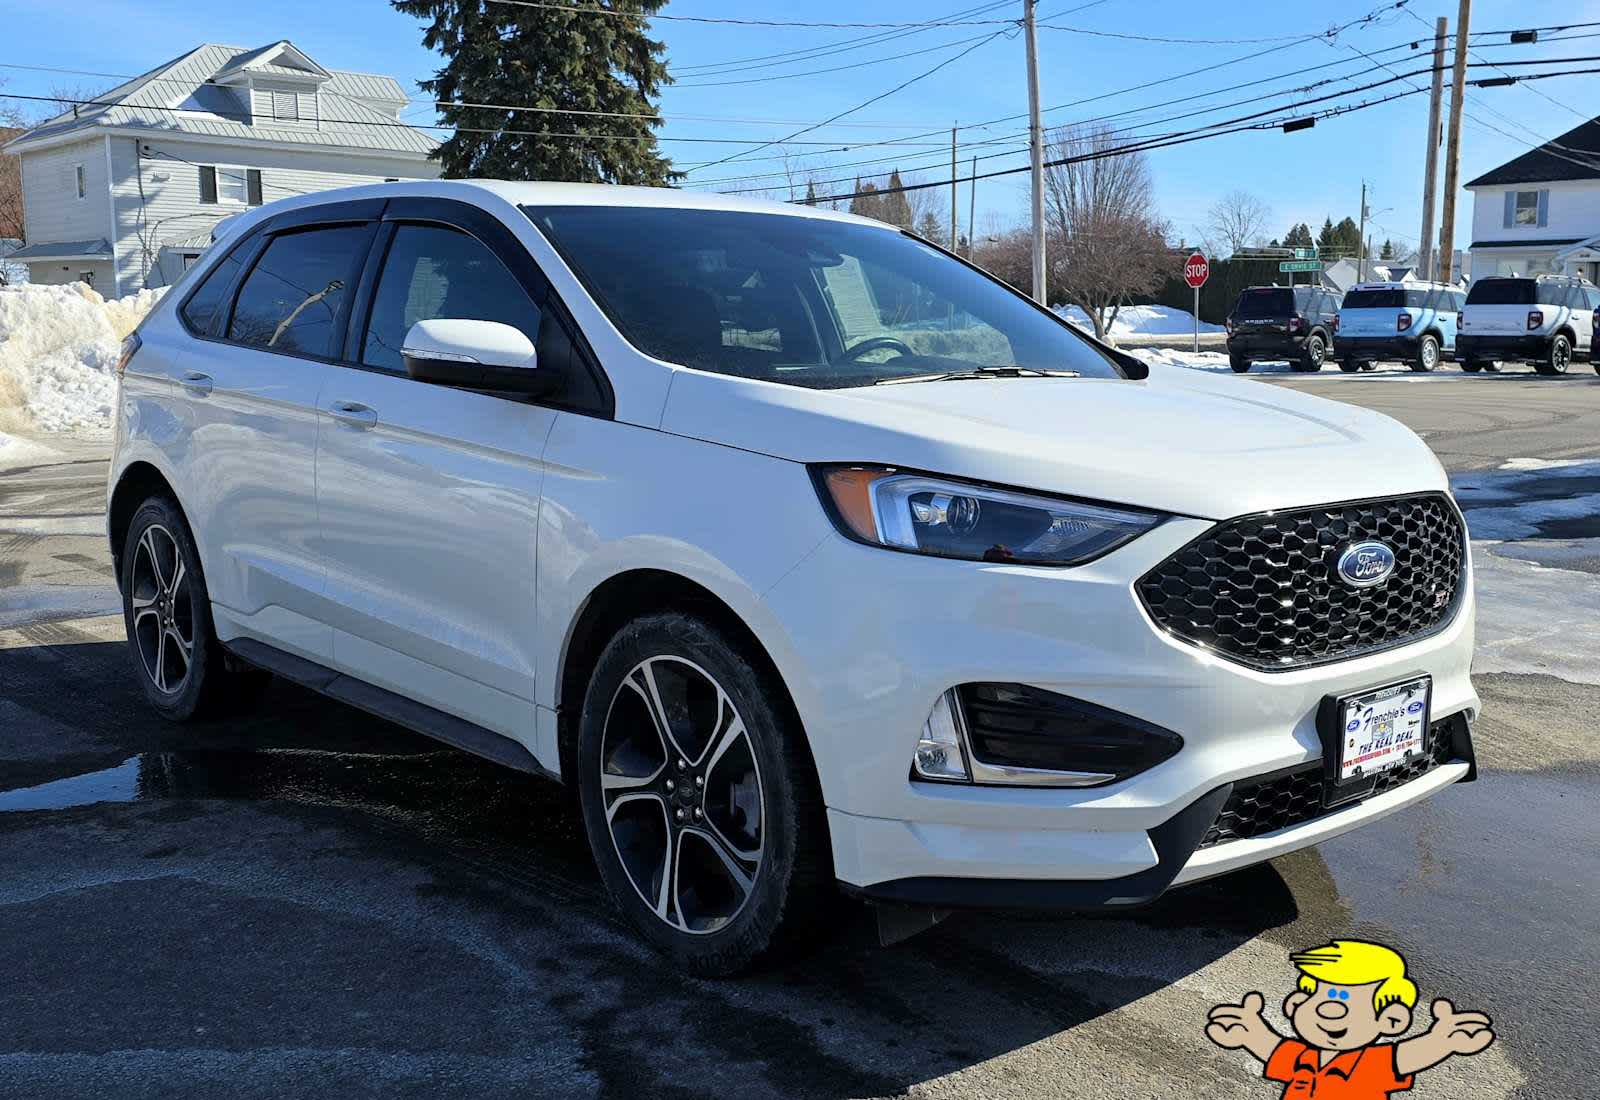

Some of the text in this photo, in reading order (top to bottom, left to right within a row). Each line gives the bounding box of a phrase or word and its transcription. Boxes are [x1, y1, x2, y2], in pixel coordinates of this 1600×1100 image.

[1186, 264, 1207, 278] STOP
[1355, 551, 1387, 577] Ford
[1362, 706, 1405, 731] Frenchie's
[1359, 742, 1373, 755] THE
[1375, 736, 1394, 751] REAL
[1395, 730, 1414, 744] DEAL
